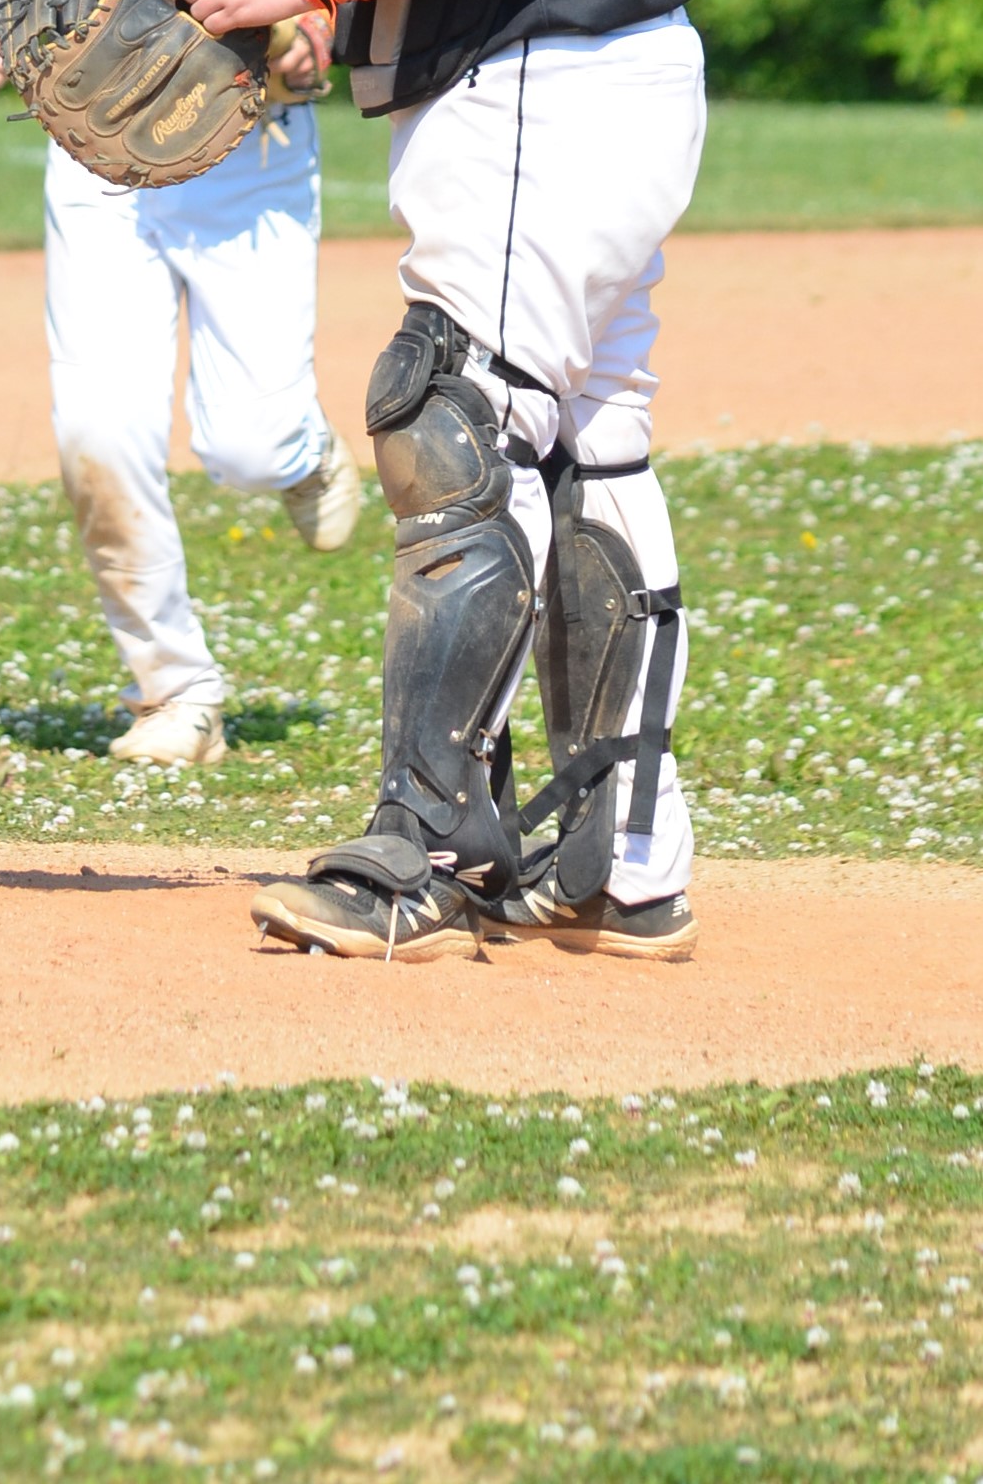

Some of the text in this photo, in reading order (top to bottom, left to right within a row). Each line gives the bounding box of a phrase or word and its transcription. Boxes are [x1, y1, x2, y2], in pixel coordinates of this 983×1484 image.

[119, 86, 139, 108] GOLD
[137, 65, 160, 89] GLOVE
[152, 82, 207, 144] Rawlings
